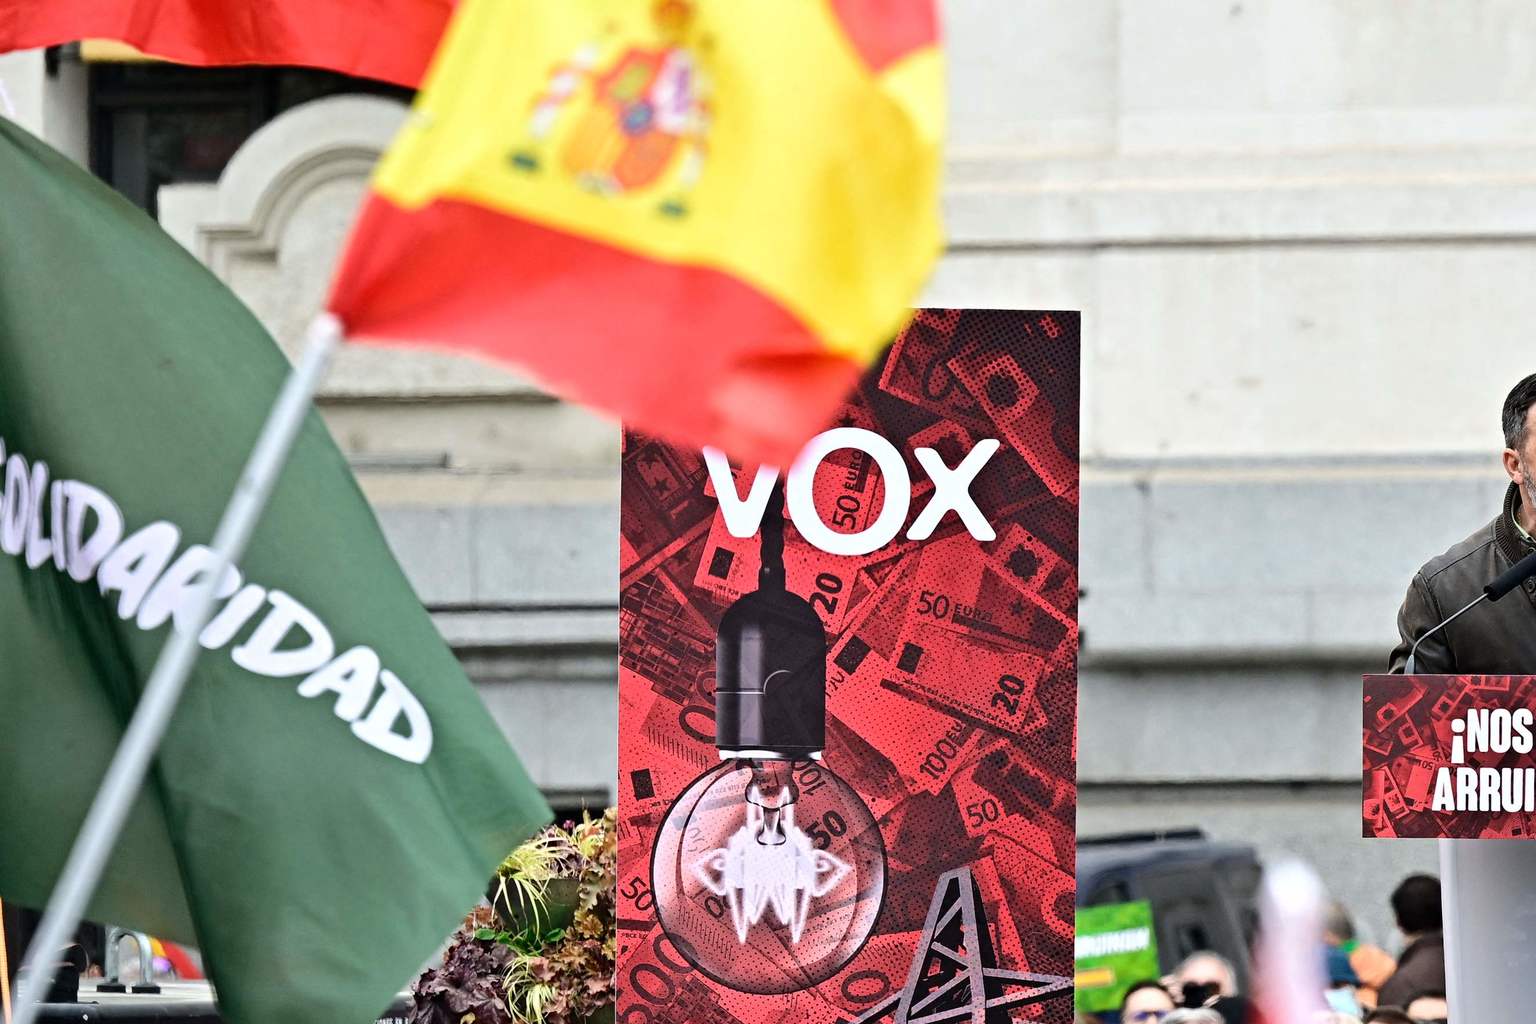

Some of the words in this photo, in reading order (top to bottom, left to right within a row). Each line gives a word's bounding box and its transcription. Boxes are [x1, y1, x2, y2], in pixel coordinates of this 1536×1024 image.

[702, 426, 1001, 557] VOX
[916, 590, 951, 620] 50
[990, 673, 1026, 717] 20
[1451, 708, 1534, 764] ¡NOS
[966, 798, 1000, 829] 50
